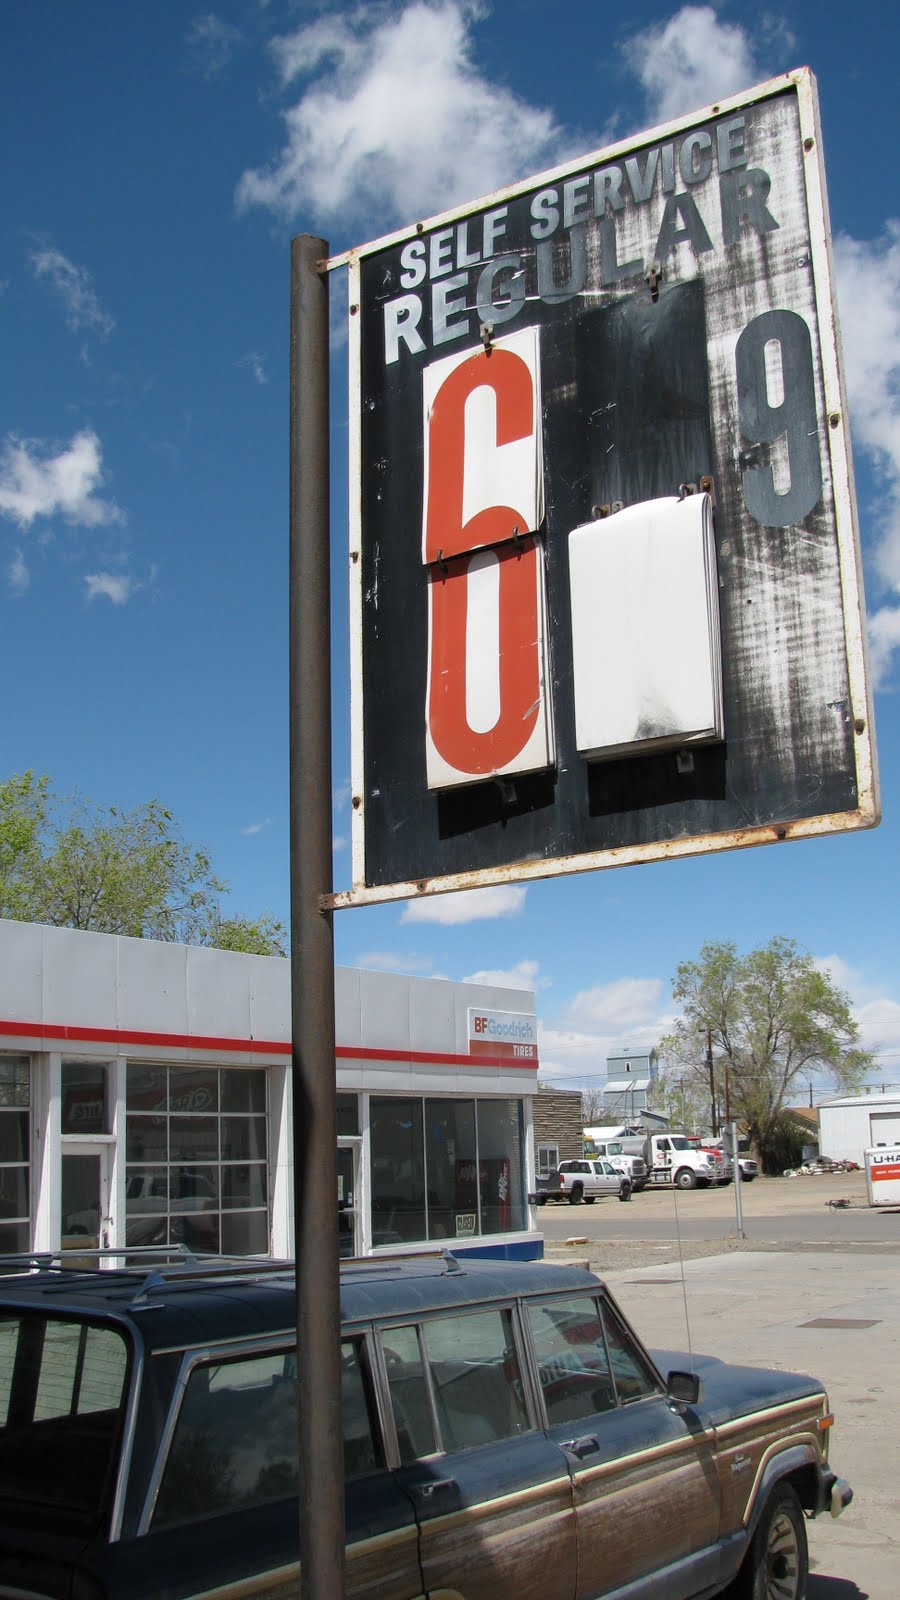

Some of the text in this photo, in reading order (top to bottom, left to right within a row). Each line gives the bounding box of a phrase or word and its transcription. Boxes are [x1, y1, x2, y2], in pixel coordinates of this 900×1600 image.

[384, 168, 780, 365] REGULAR
[400, 116, 749, 290] SELF SERVICE
[734, 308, 822, 527] 9
[474, 1016, 533, 1038] BFGoodrich
[512, 1045, 534, 1057] TIRES
